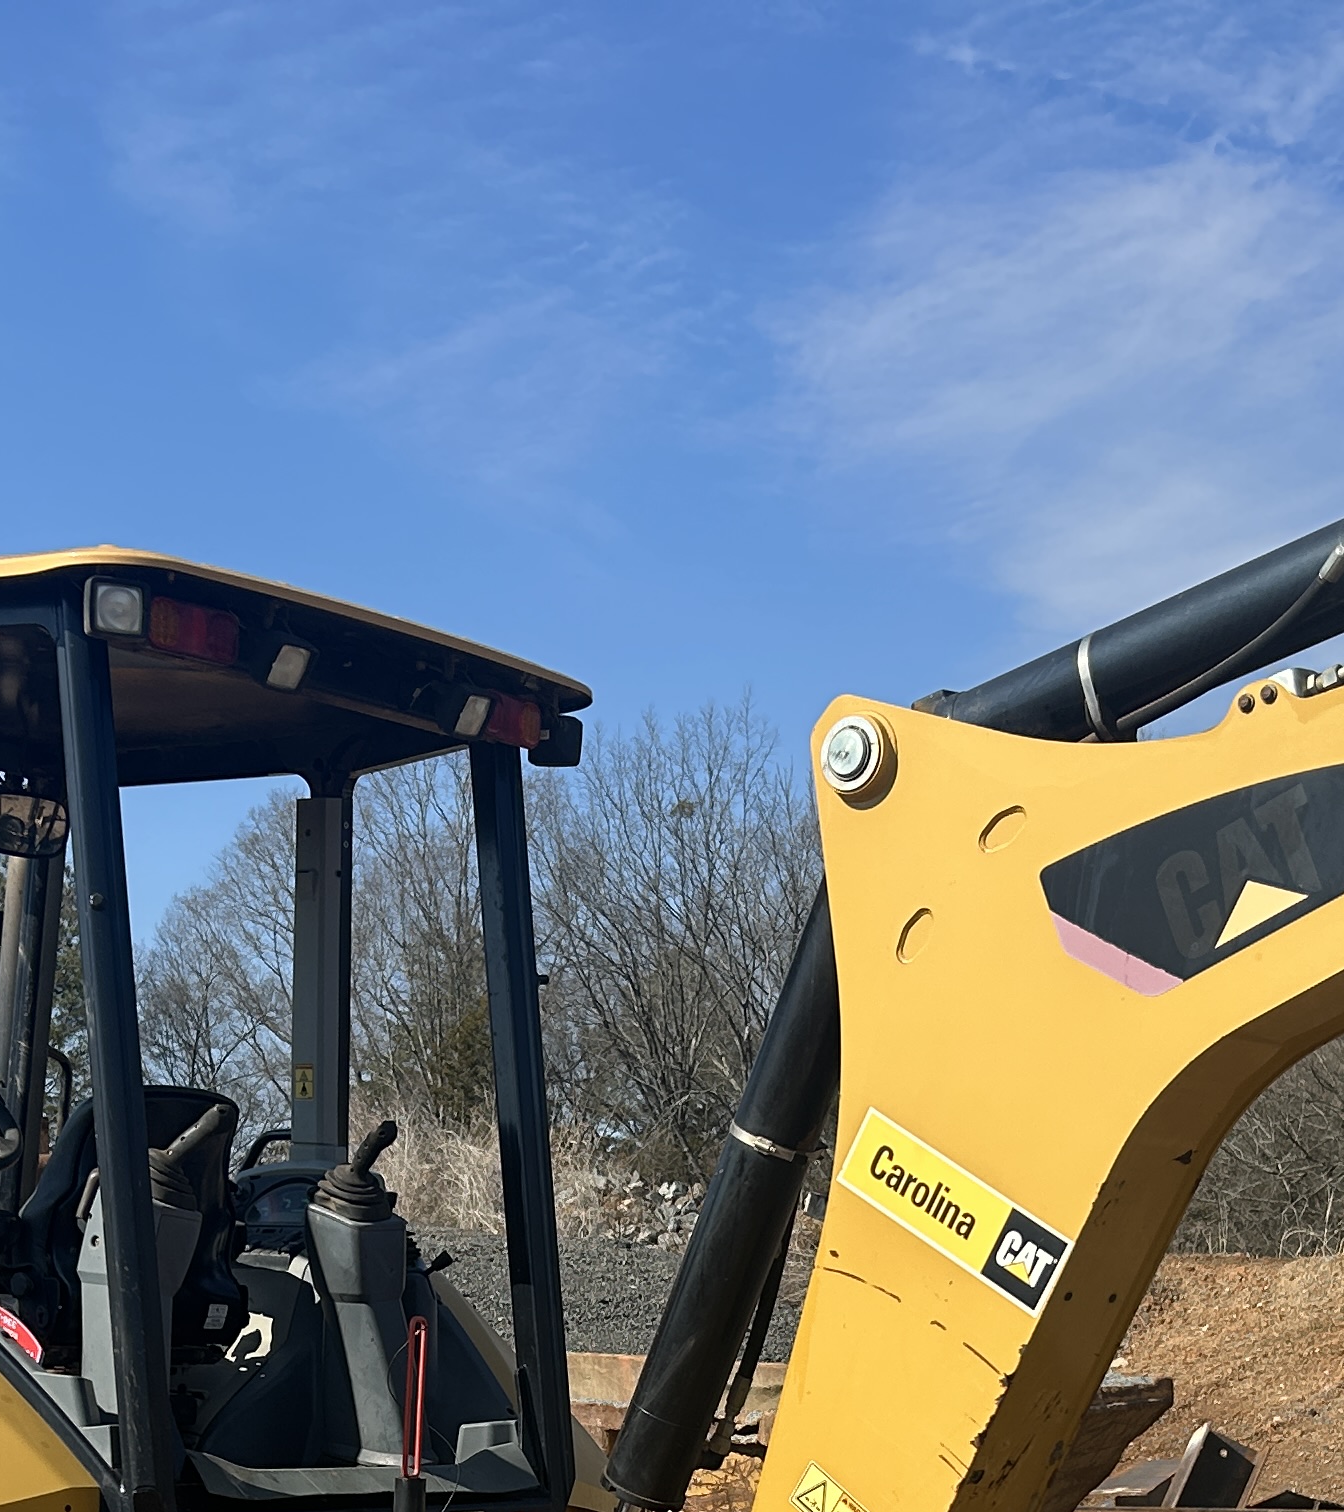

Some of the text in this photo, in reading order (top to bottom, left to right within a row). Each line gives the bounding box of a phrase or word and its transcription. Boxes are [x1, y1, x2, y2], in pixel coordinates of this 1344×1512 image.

[1156, 782, 1323, 960] CAT
[869, 1145, 1054, 1289] Carolina CAT
